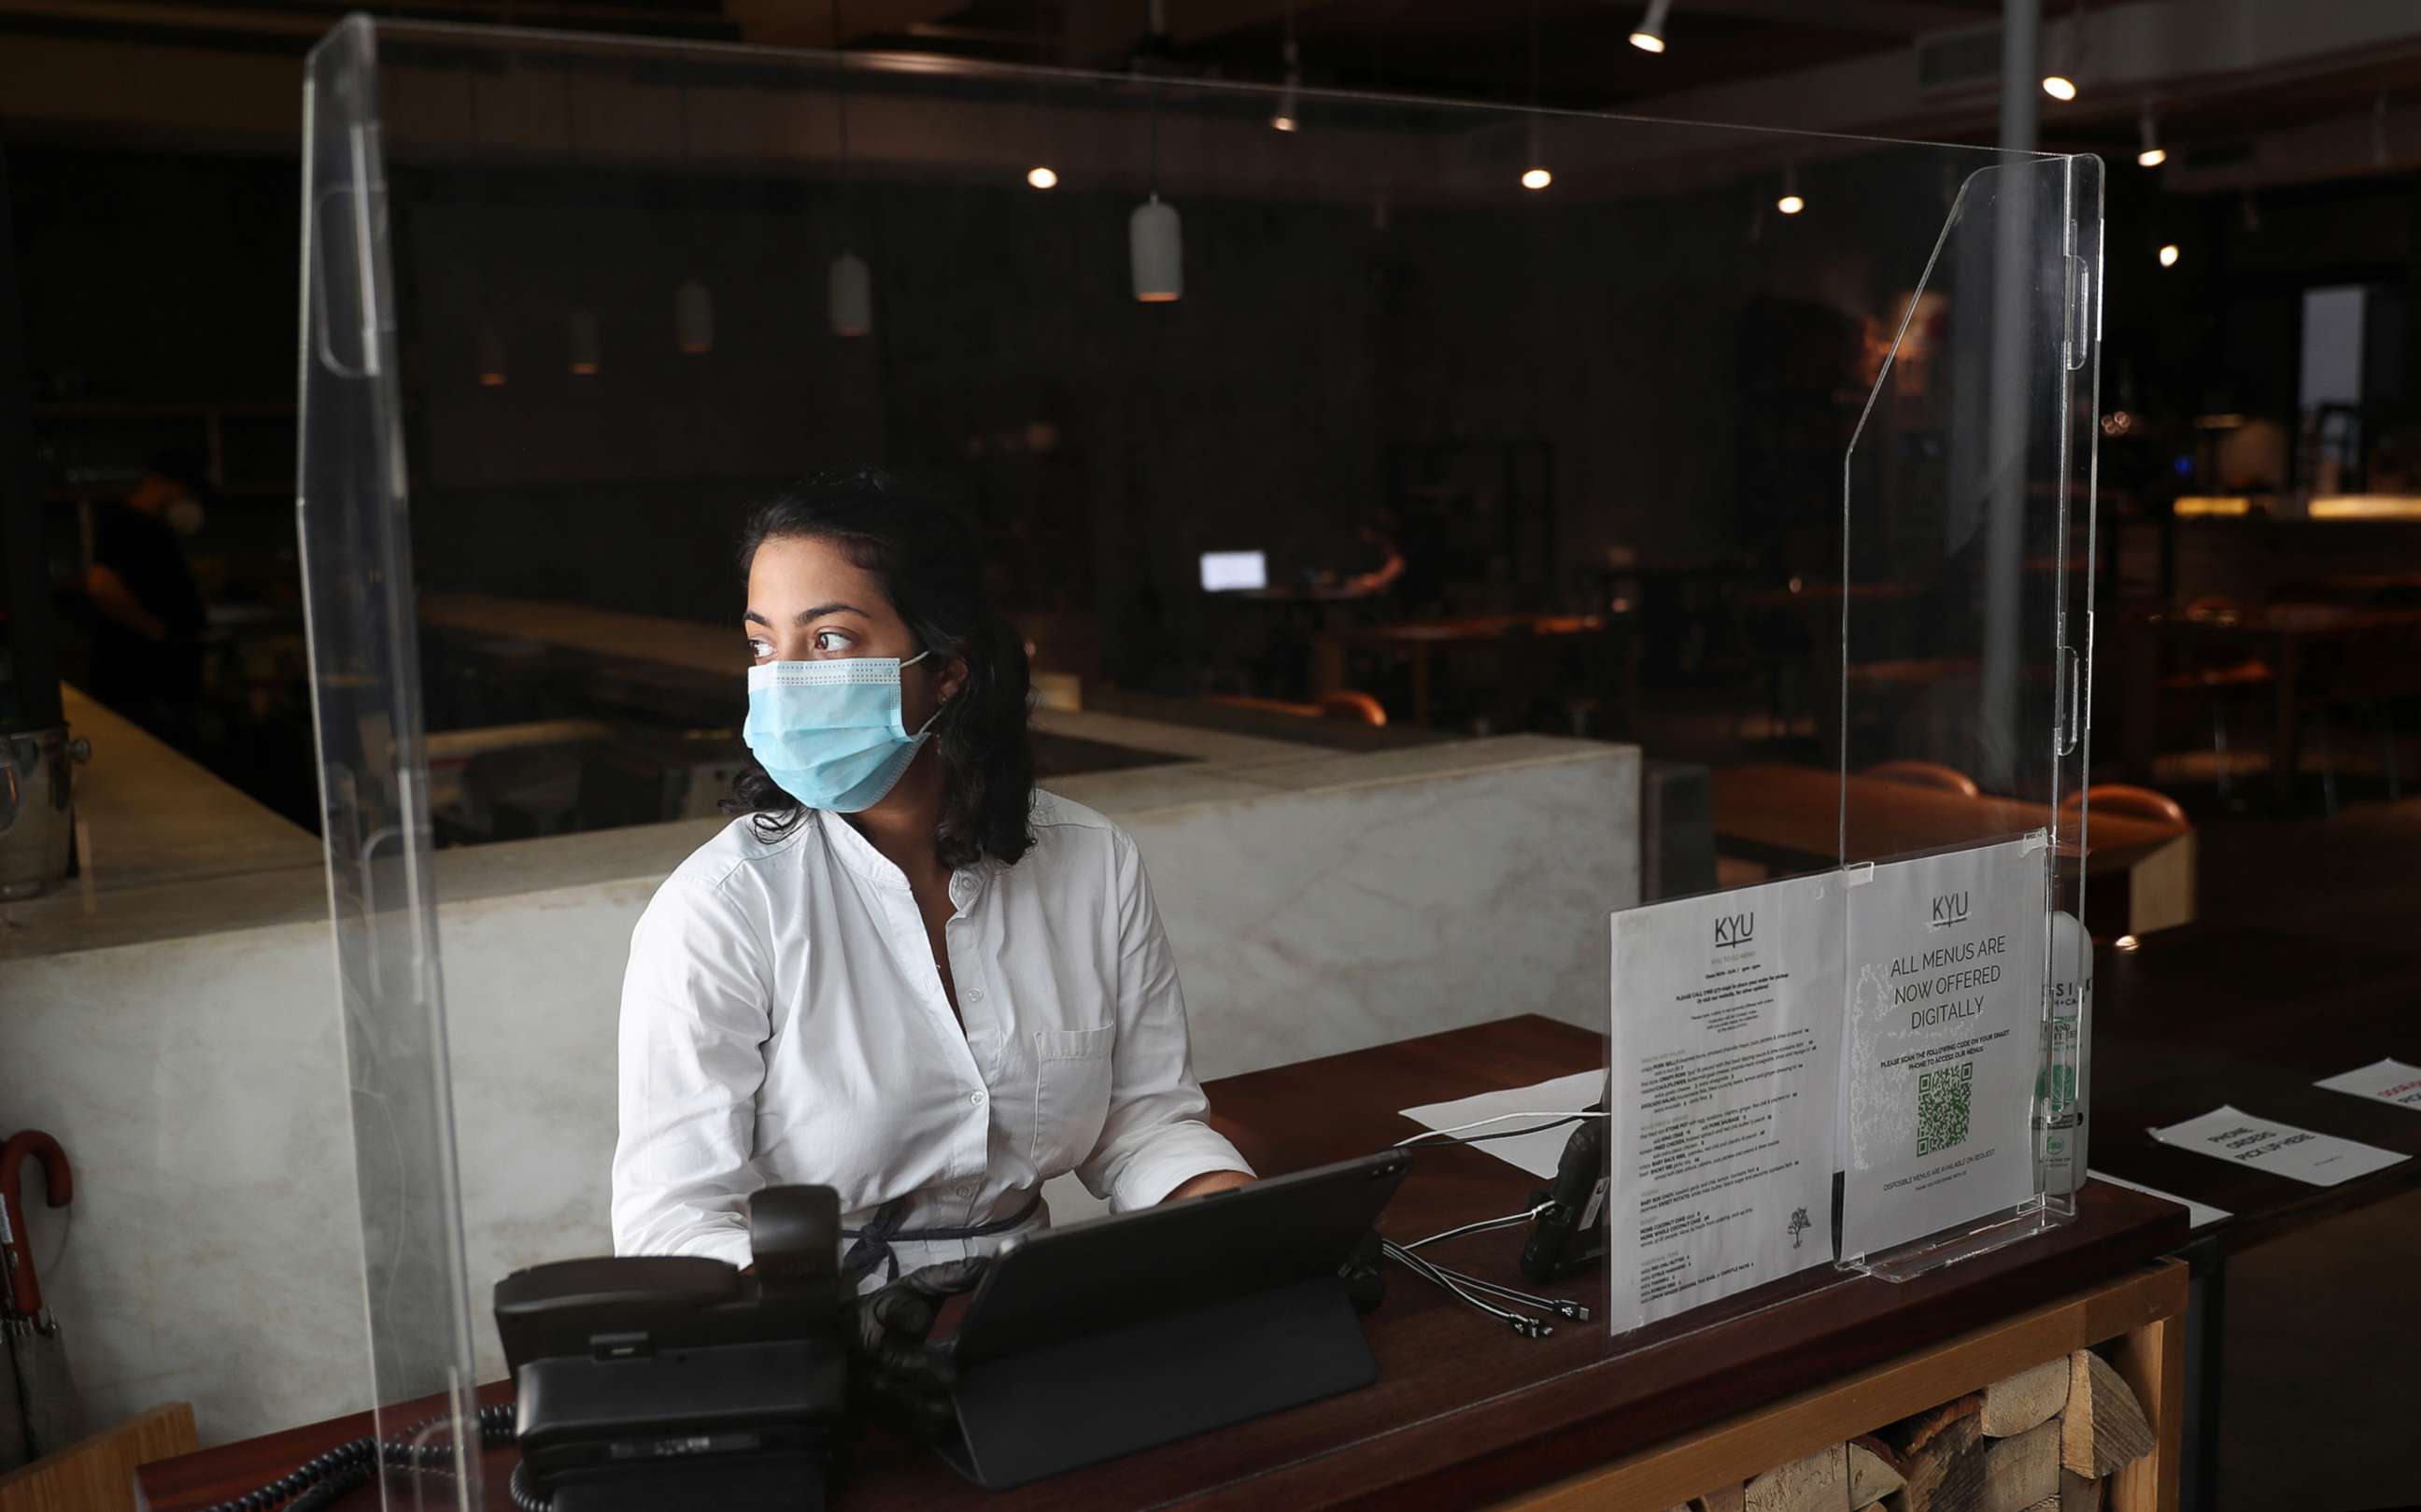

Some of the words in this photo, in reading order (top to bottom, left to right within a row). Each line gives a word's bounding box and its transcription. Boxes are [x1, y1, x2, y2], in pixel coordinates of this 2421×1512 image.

[1933, 891, 1970, 927] KYU
[1715, 911, 1754, 948] KYU
[1890, 957, 1918, 977] ALL
[1922, 942, 1975, 970] MENUS
[1976, 936, 2006, 957] ARE
[1894, 980, 1933, 1005] NOW
[1935, 965, 2002, 994] OFFERED
[1911, 996, 1985, 1029] DIGITALLY
[1880, 1059, 1900, 1068] PLEASE
[1916, 1052, 1925, 1060] THE
[1957, 1039, 1970, 1050] CODE
[1979, 1033, 1993, 1044] YOUR
[1908, 1060, 1928, 1071] PHONE
[2207, 1127, 2253, 1143] PHONE
